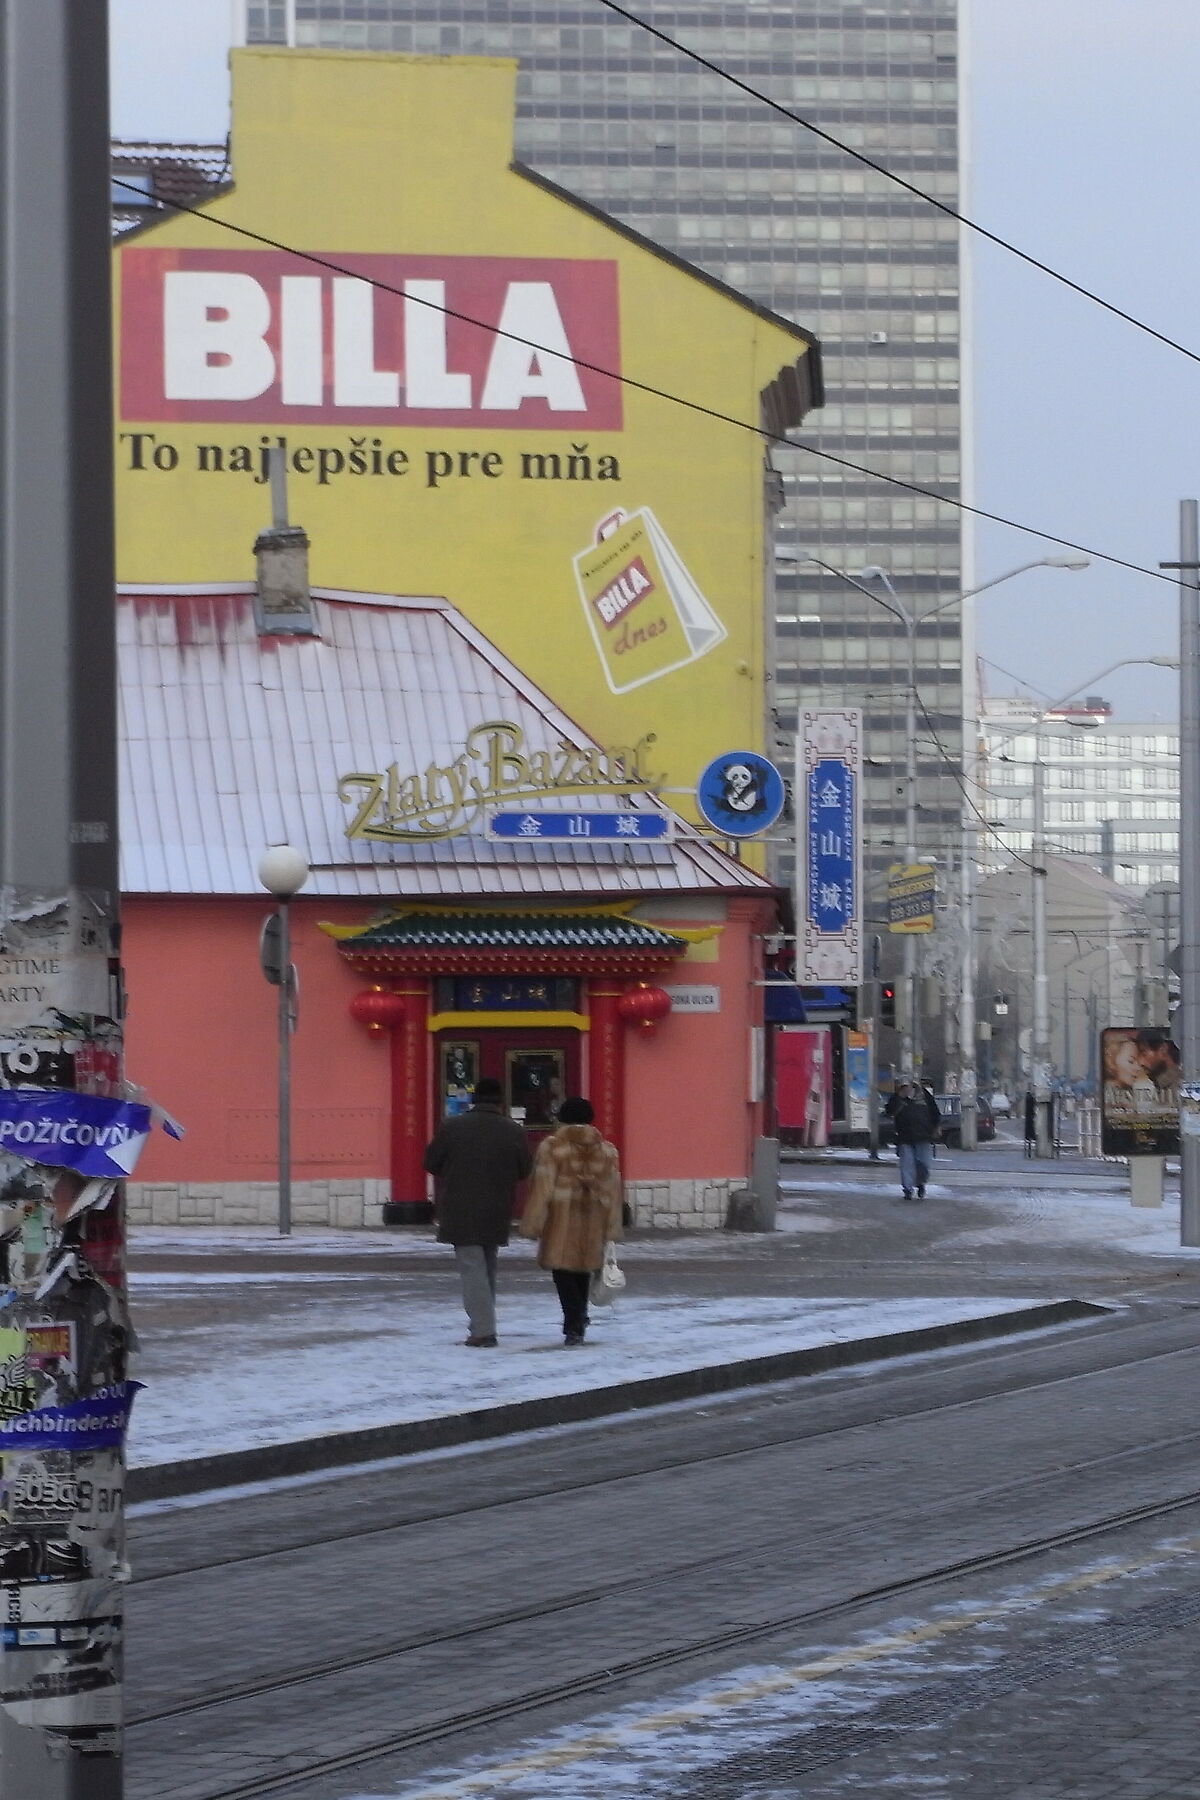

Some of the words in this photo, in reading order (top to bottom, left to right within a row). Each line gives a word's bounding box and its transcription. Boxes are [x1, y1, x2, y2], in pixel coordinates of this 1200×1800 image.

[163, 270, 588, 412] BILLA
[120, 433, 178, 472] To
[426, 446, 503, 488] pre
[520, 443, 622, 482] mňa
[597, 566, 651, 623] BILLA
[614, 617, 668, 656] dnes
[338, 754, 486, 844] Zlatý
[465, 720, 668, 802] Bažant
[517, 814, 641, 837] 金山城
[818, 779, 842, 912] 金山城
[0, 1117, 138, 1147] POŽIČOVŇ
